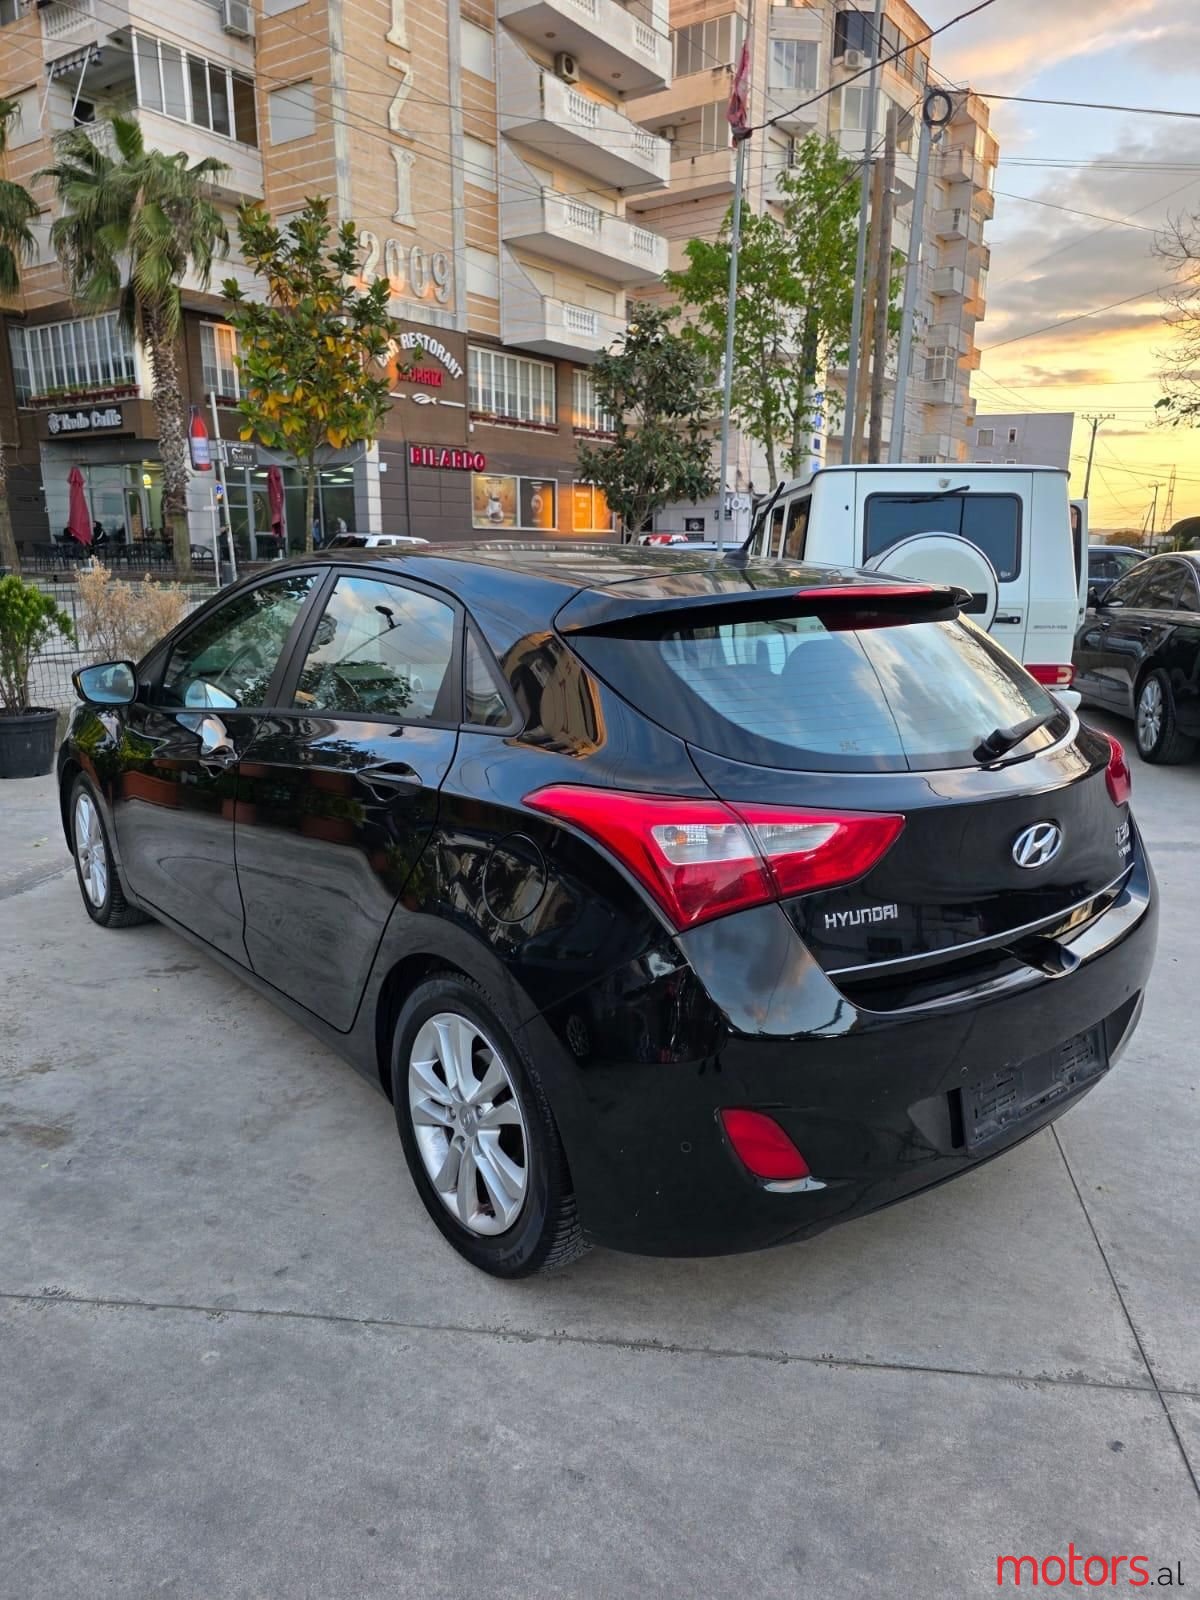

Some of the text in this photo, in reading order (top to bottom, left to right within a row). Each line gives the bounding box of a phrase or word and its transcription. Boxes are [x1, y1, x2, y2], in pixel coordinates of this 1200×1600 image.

[357, 230, 452, 304] 2009
[400, 331, 464, 379] RESTORANT
[409, 447, 486, 472] BILARDO
[824, 903, 898, 929] HYUNDAI
